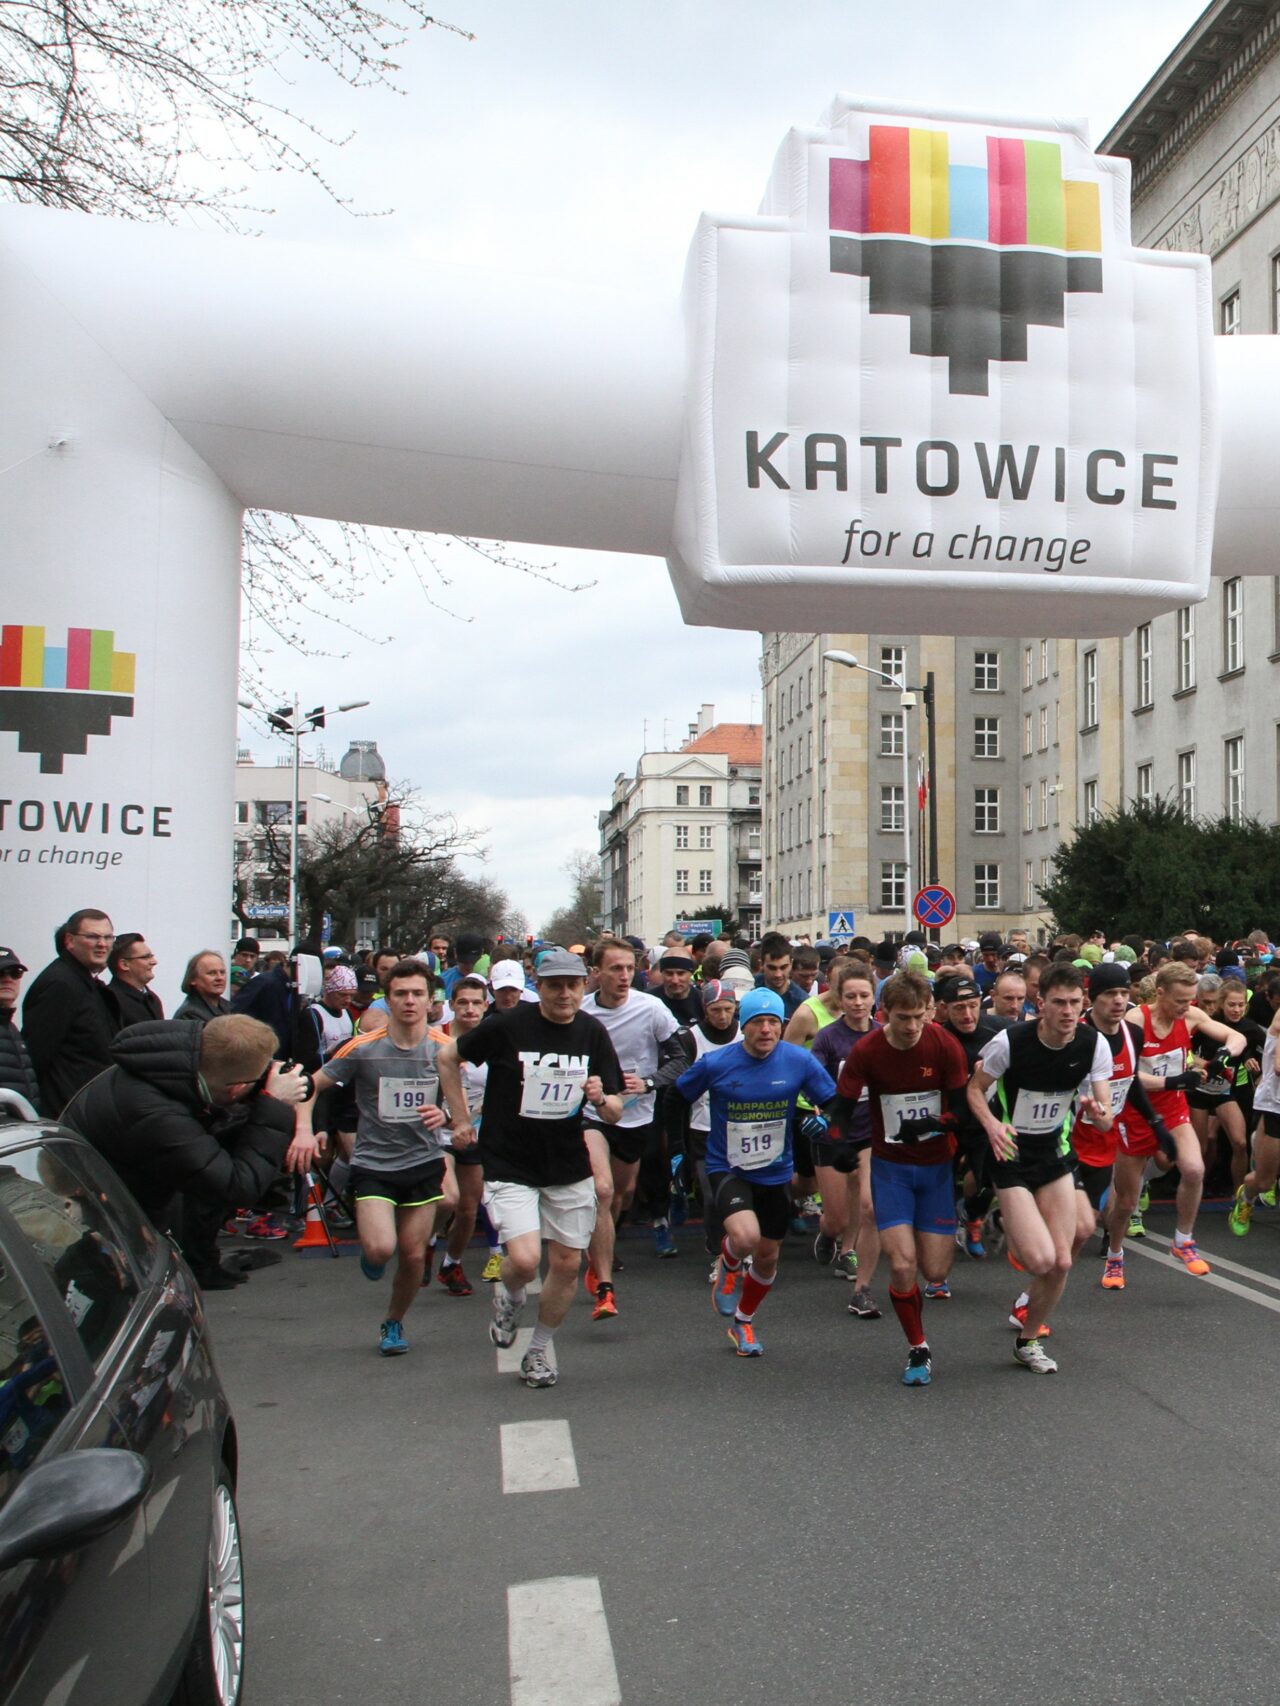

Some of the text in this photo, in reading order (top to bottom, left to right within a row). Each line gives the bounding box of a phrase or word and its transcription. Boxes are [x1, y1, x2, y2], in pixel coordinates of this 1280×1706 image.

[745, 429, 1179, 510] KATOWICE
[841, 519, 1092, 572] for a change
[18, 849, 31, 863] a
[38, 845, 123, 870] change
[394, 1091, 424, 1108] 199
[541, 1083, 573, 1101] 717
[727, 1100, 789, 1111] HARPAGAN
[1033, 1102, 1060, 1119] 116
[741, 1134, 771, 1154] 519
